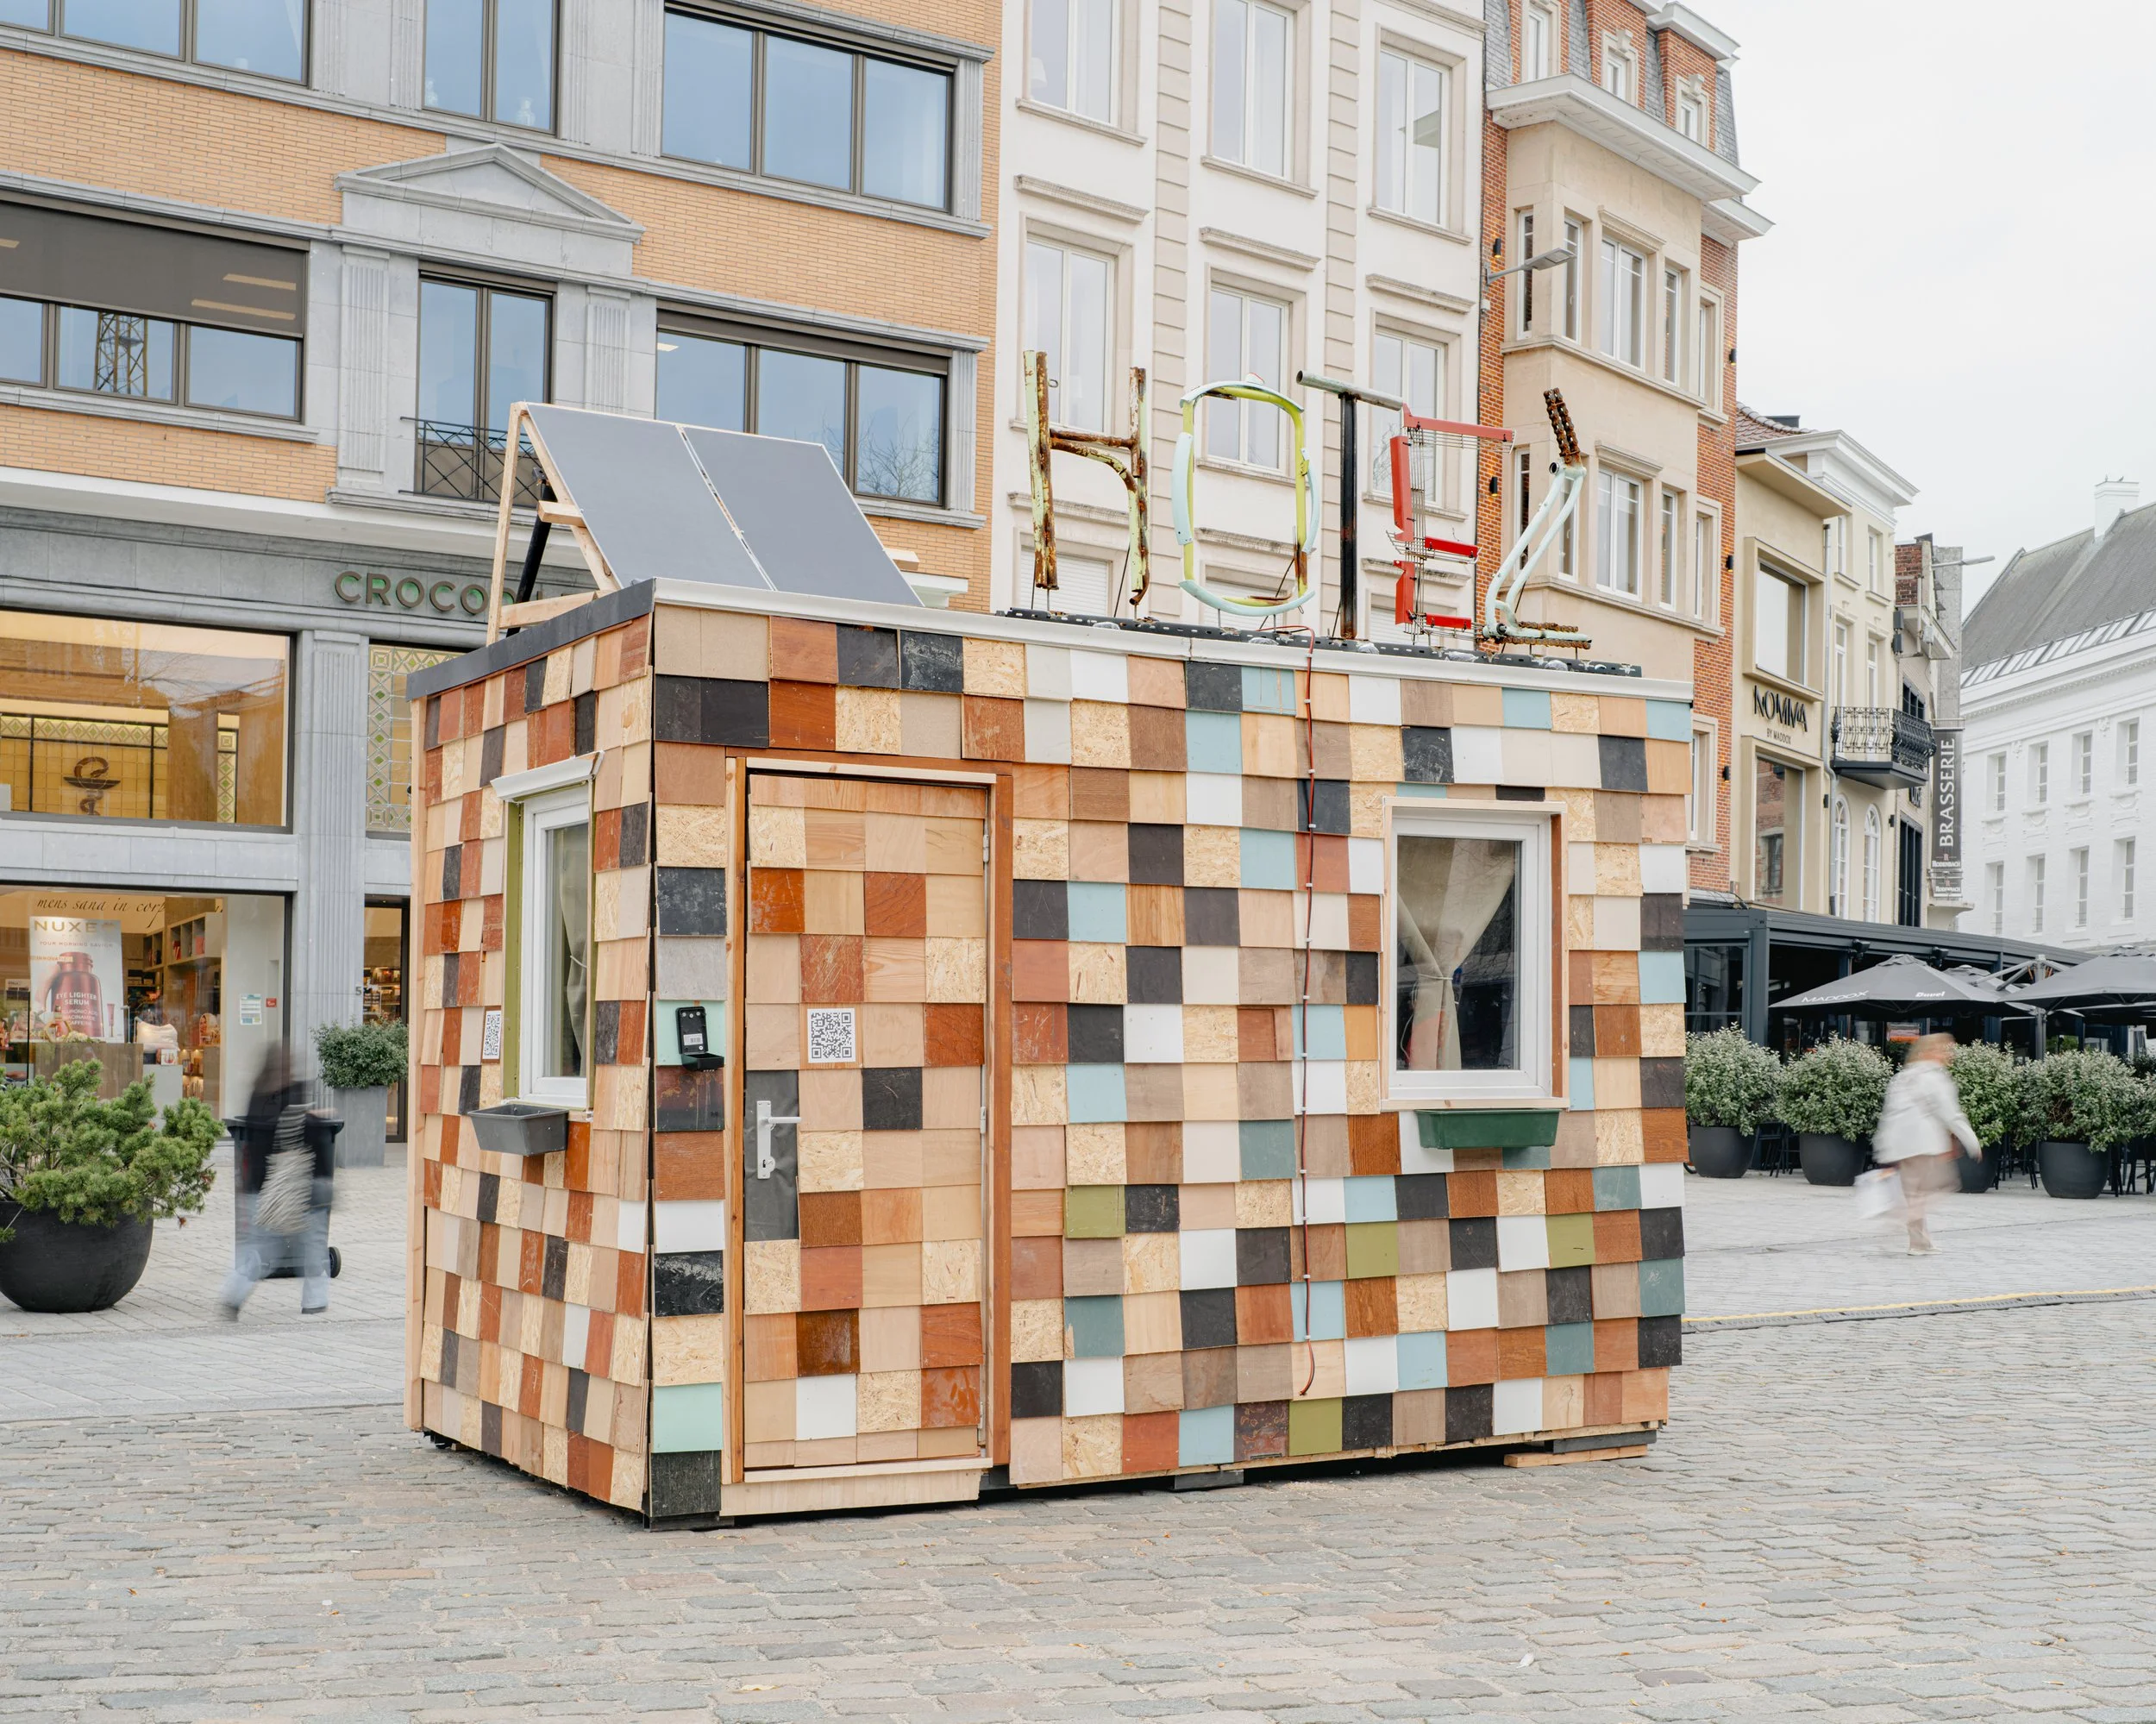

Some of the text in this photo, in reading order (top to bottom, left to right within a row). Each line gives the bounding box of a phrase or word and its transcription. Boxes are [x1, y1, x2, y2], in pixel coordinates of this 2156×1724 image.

[1024, 349, 1592, 649] HOTEL
[335, 570, 573, 615] CROCO
[1753, 684, 1808, 733] NOMMA
[1766, 728, 1792, 745] BY MADDOX
[1940, 737, 1955, 847] BRASSERIE
[36, 897, 67, 909] mens
[72, 900, 104, 912] sana
[113, 897, 128, 912] in
[34, 920, 97, 933] NUXE
[69, 992, 97, 1000] LIGHTER
[355, 986, 362, 995] 5
[1801, 990, 1870, 1003] MADDOX
